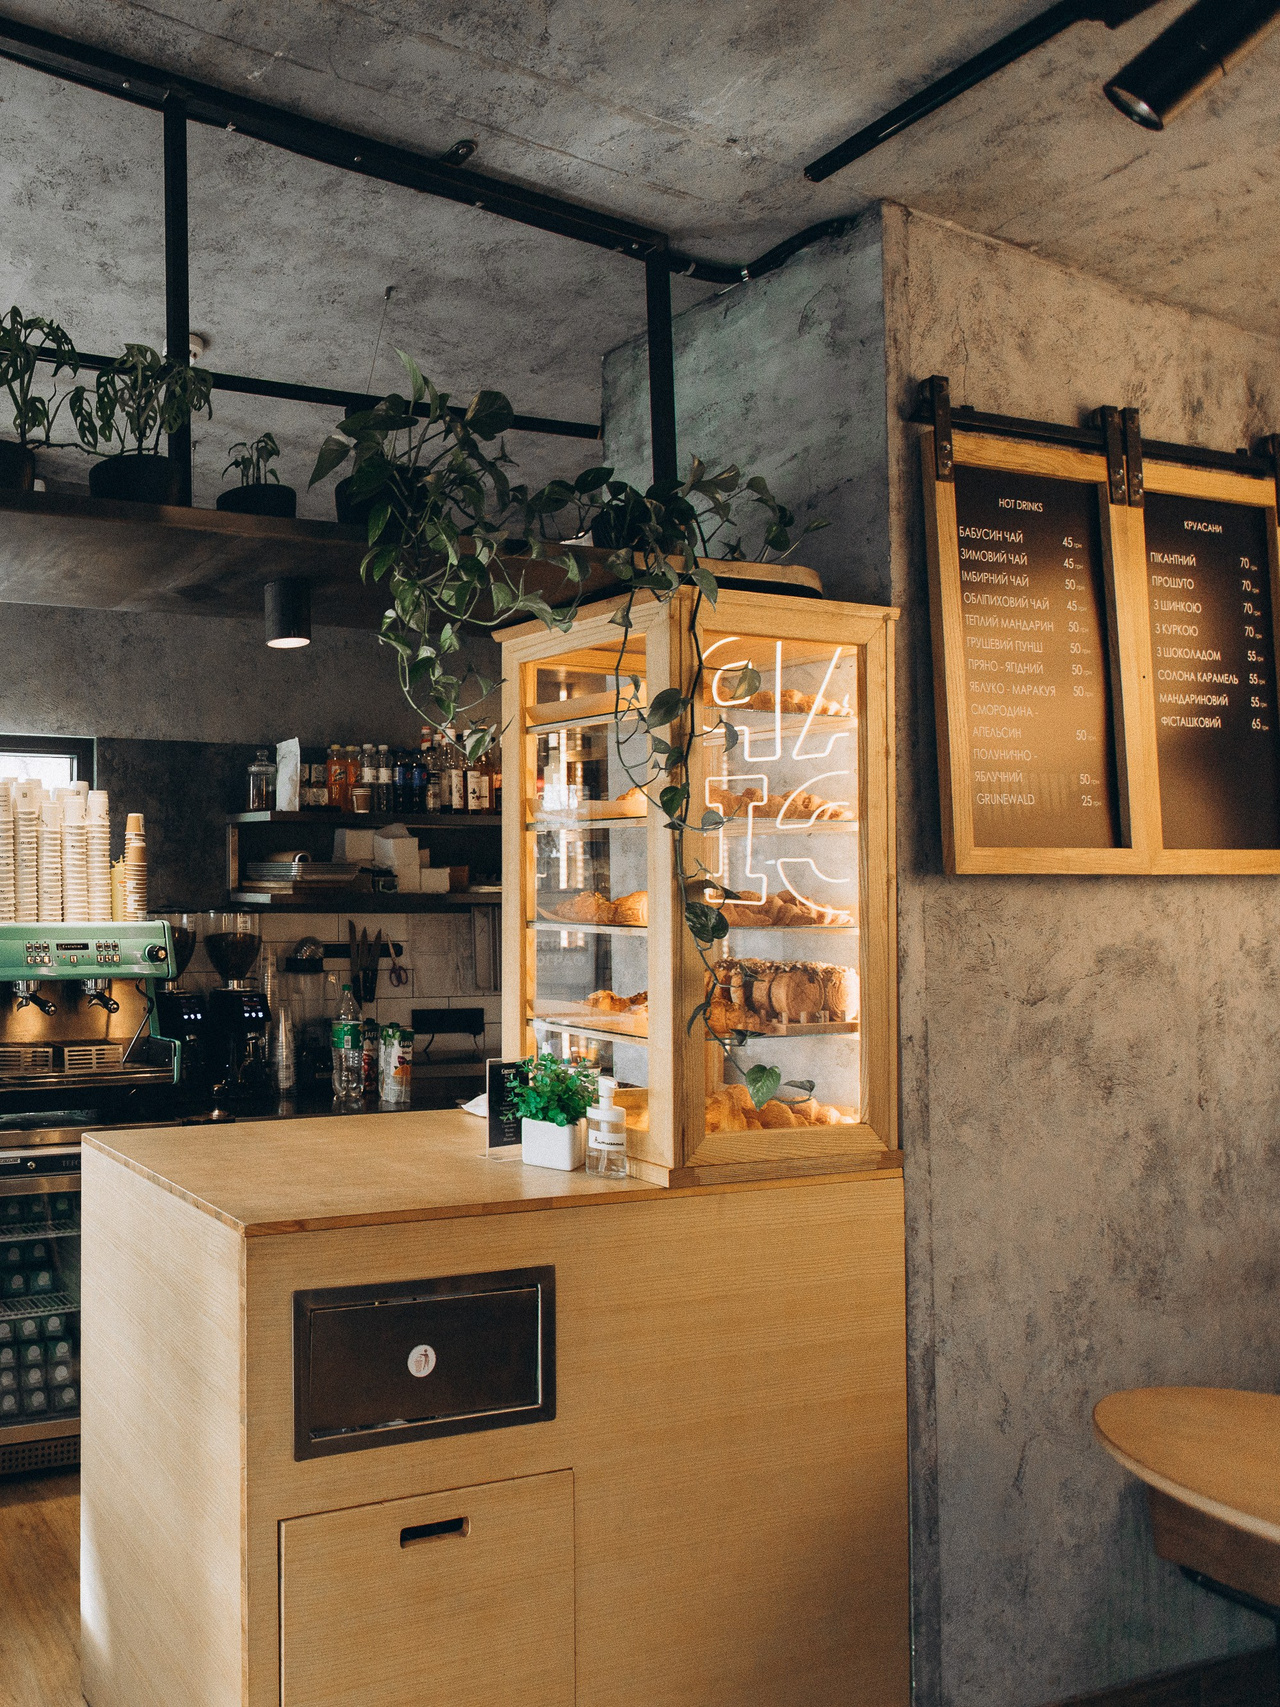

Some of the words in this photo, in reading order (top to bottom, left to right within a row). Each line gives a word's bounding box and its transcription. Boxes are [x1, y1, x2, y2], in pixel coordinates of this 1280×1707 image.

[998, 498, 1015, 509] HOT
[1016, 500, 1043, 512] DRINKS
[1184, 520, 1222, 533] КРУАСАНИ
[959, 526, 1002, 541] БАБУСИН
[1004, 530, 1023, 543] ЧАЙ
[1062, 537, 1073, 547] 45
[960, 548, 1007, 563] ЗИМОВИЙ
[1008, 552, 1027, 565] ЧАЙ
[1063, 558, 1074, 569] 45
[1150, 552, 1196, 566] ПІКАНТНИЙ
[1240, 558, 1250, 569] 70
[961, 570, 1008, 585] ІМБИРНИЙ
[1010, 574, 1029, 587] ЧАЙ
[1064, 579, 1075, 590] 50
[1152, 576, 1195, 590] ПРОШУТО
[1241, 580, 1252, 591] 70
[963, 592, 1028, 609] ОБЛІПИХОВИЙ
[1030, 597, 1050, 610] ЧАЙ
[1066, 601, 1077, 611] 45
[1160, 602, 1202, 613] ШИНКОЮ
[1243, 603, 1253, 614] 70
[964, 614, 998, 627] ТЕПЛИЙ
[1000, 619, 1054, 632] МАНДАРИН
[1068, 622, 1079, 633] 50
[1162, 624, 1198, 637] КУРКОЮ
[1244, 626, 1255, 637] 70
[966, 637, 1013, 651] ГРУШЕВИЙ
[1015, 640, 1043, 653] ПУНШ
[1070, 643, 1081, 654] 50
[1163, 647, 1221, 661] ШОКОЛАДОМ
[1247, 650, 1256, 661] 55
[968, 658, 998, 672] ПРЯНО
[1071, 665, 1082, 675] 50
[1157, 669, 1195, 682] СОЛОНА
[1197, 672, 1239, 685] КАРАМЕЛЬ
[1249, 673, 1258, 684] 55
[969, 681, 1004, 694] ЯБЛУКО
[1012, 684, 1056, 697] МАРАКУЯ
[1073, 686, 1084, 697] 50
[1159, 693, 1228, 706] МАНДАРИНОВИЙ
[1250, 696, 1260, 708] 55
[971, 703, 1033, 718] СМОРОДИНА
[1161, 716, 1222, 729] ФІСТАШКОВИЙ
[1251, 718, 1261, 730] 65
[972, 726, 1022, 739] АПЕЛЬСИН
[1076, 730, 1087, 741] 50
[973, 748, 1032, 761] ПОЛУНИЧНО
[974, 769, 1023, 783] ЯБЛУЧНИЙ
[1079, 774, 1090, 785] 50
[976, 793, 1035, 805] GRUNEWALD
[1081, 795, 1092, 806] 25
